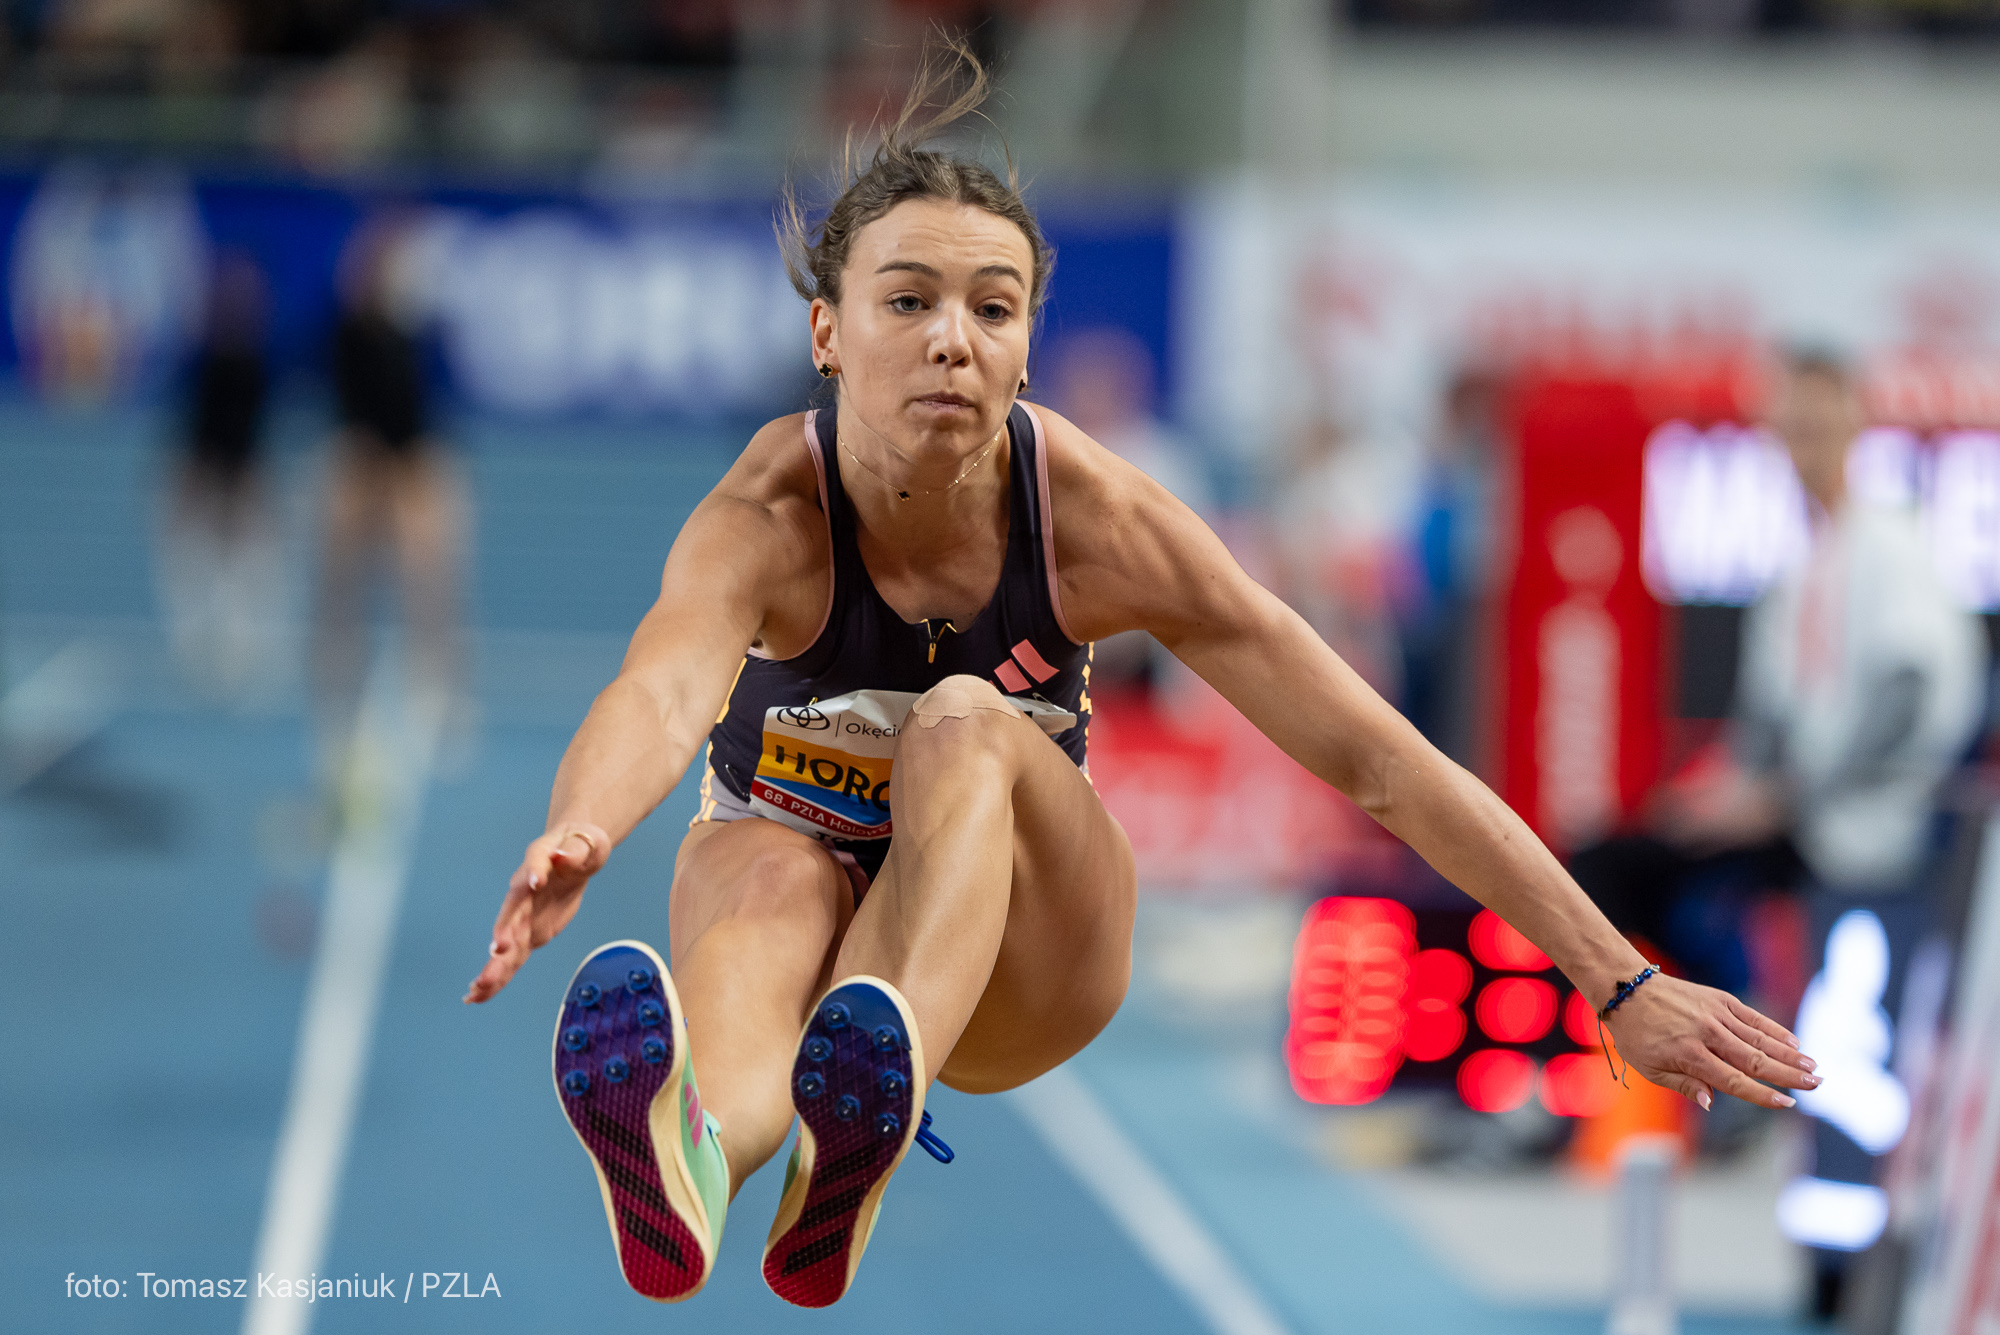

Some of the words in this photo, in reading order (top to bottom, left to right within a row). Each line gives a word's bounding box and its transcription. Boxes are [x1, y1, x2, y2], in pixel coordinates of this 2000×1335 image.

[845, 722, 901, 739] Okęci
[763, 788, 787, 807] 68.
[790, 800, 825, 823] PZLA
[829, 818, 889, 836] Halowe
